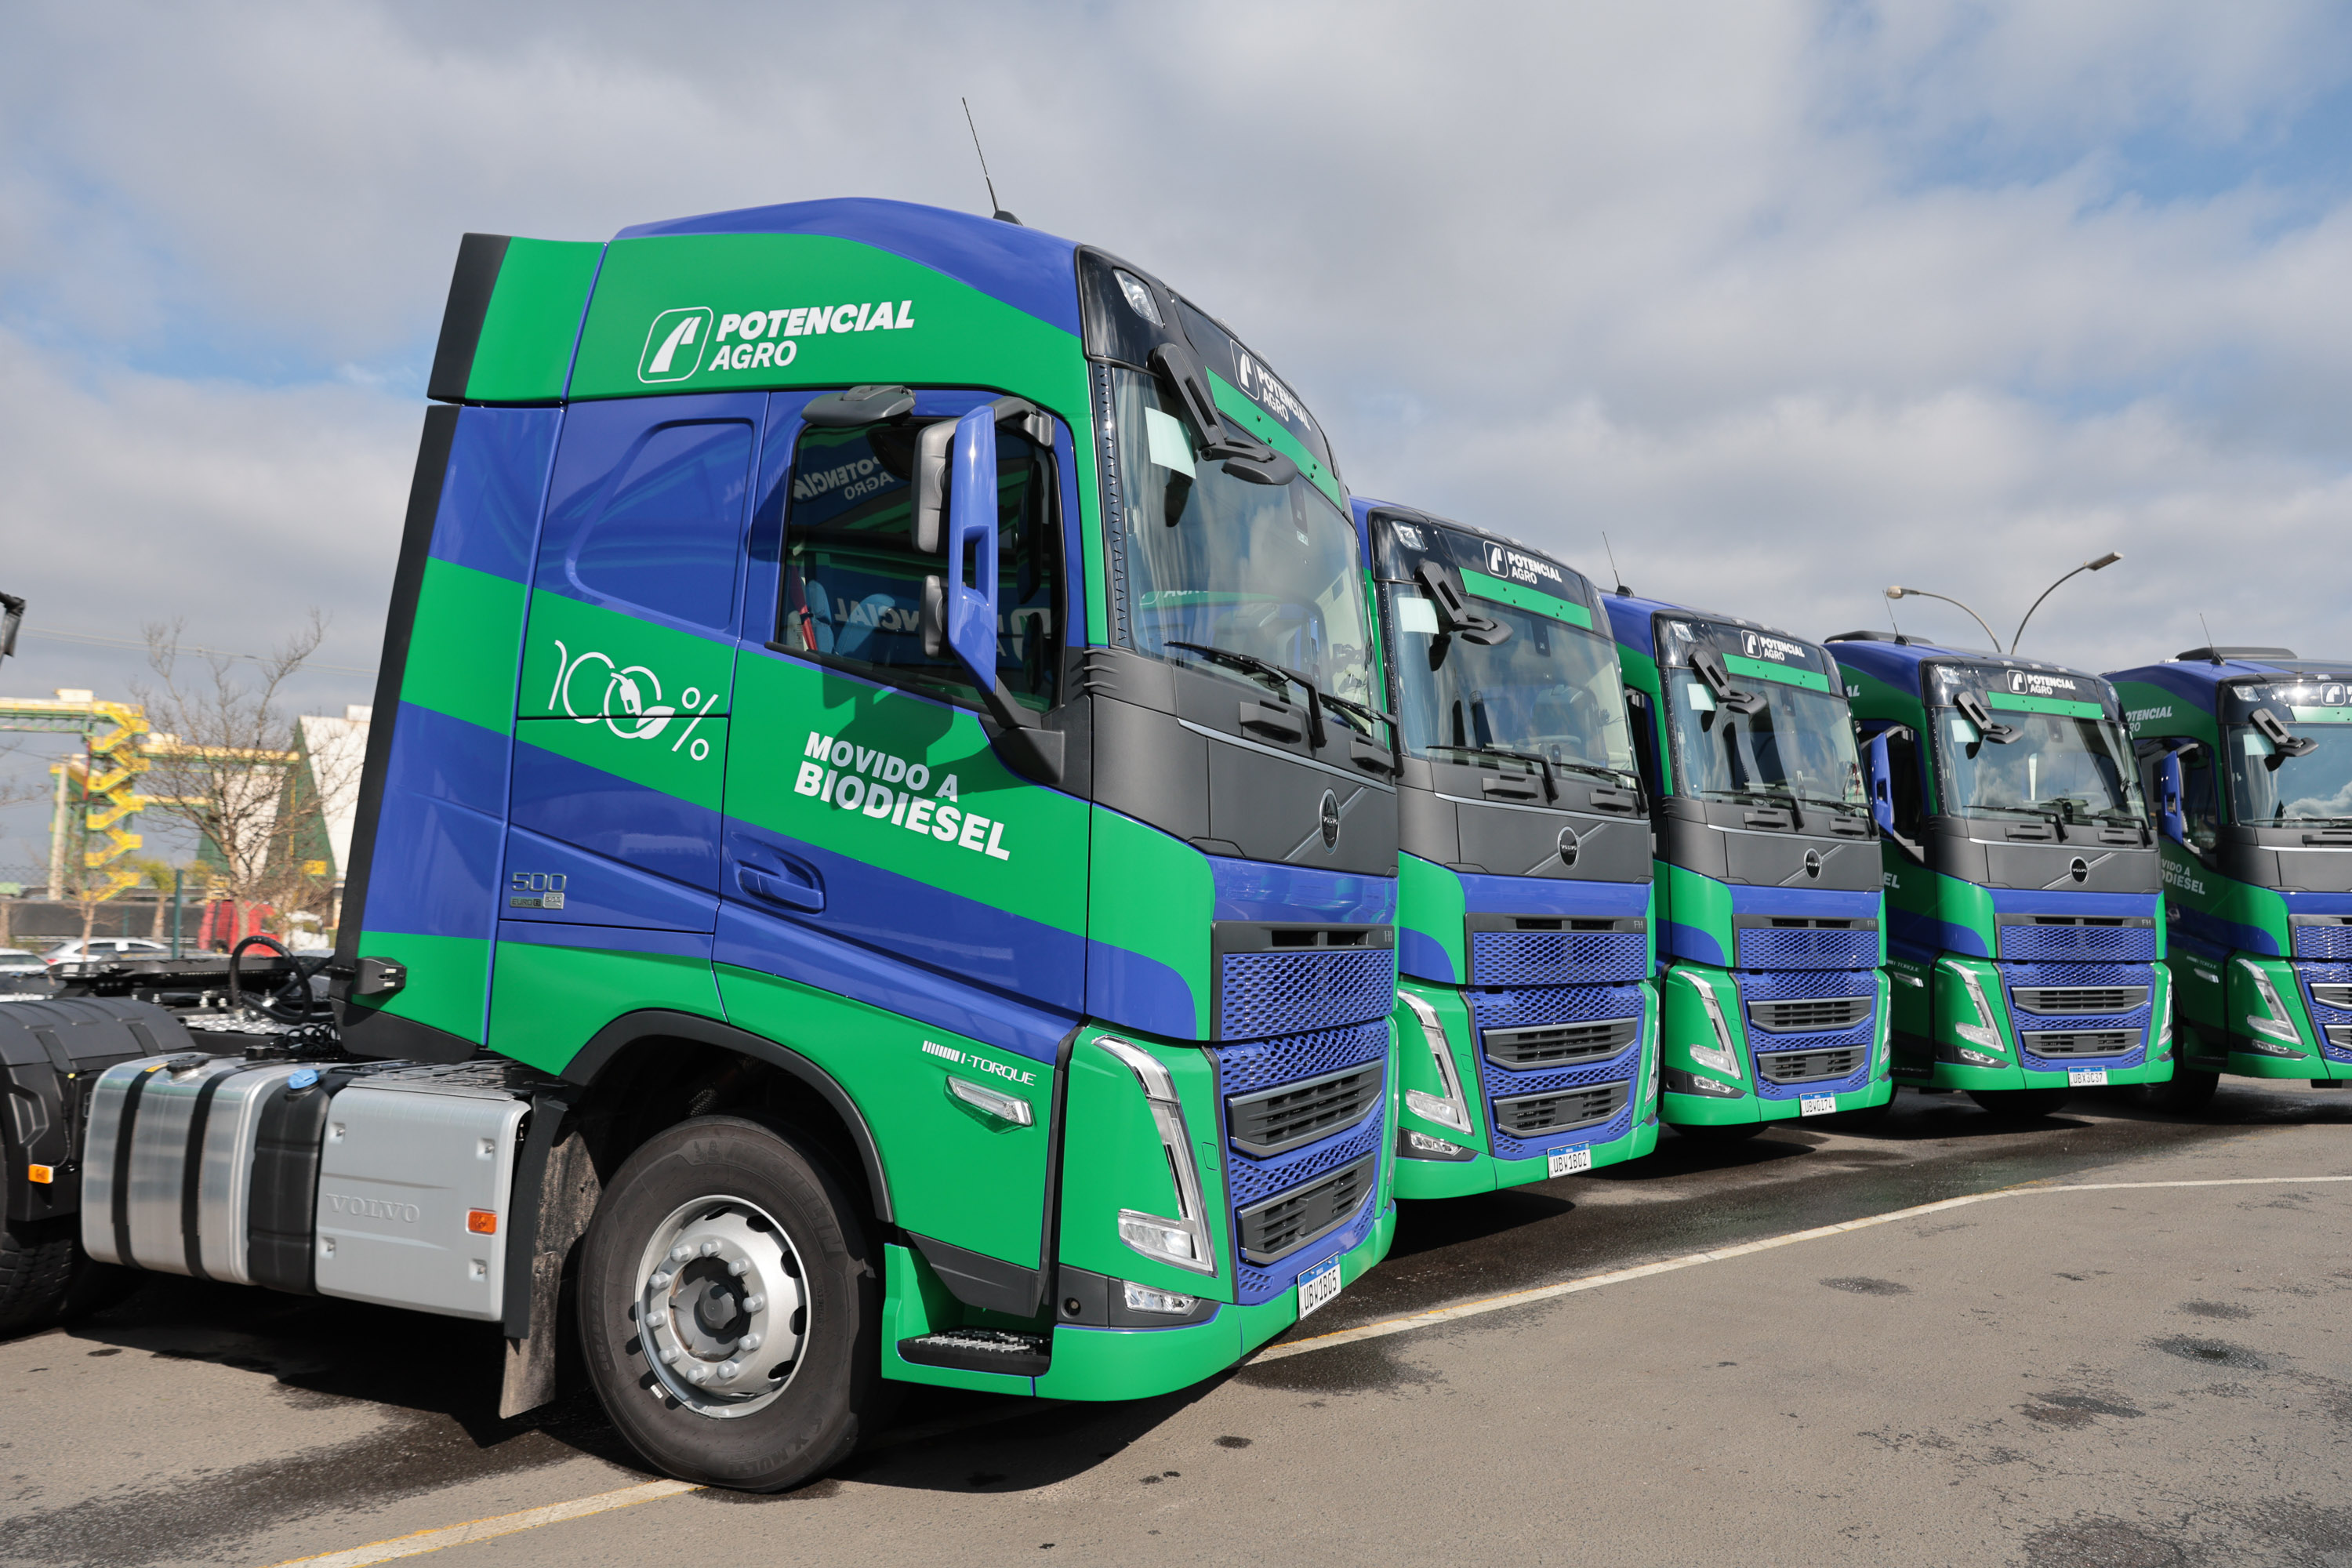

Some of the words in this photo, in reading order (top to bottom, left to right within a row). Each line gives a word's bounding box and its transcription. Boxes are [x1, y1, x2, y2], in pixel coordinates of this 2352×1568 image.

[715, 300, 915, 342] POTENCIAL
[708, 340, 797, 372] AGRO
[1256, 363, 1312, 431] POTENCIAL
[1262, 387, 1290, 423] AGRO
[1507, 550, 1563, 583] POTENCIAL
[1512, 566, 1537, 585] AGRO
[1760, 636, 1805, 658] POTENCIAL
[1764, 647, 1785, 662] AGRO
[2027, 676, 2076, 691] POTENCIAL
[2030, 684, 2053, 695] AGRO
[2125, 706, 2172, 721] OTENCIAL
[803, 731, 930, 792] MOVIDO
[935, 773, 958, 804] A
[793, 760, 1011, 862] BIODIESEL
[2161, 858, 2183, 873] VIDO
[2183, 866, 2190, 877] A
[511, 872, 567, 892] 500
[1634, 920, 1643, 929] FH
[960, 1052, 1037, 1087] I-TORQUE
[2073, 1073, 2103, 1083] UBX3C37
[1553, 1152, 1587, 1173] UBW1B02
[326, 1193, 420, 1223] VOLVO
[1304, 1269, 1337, 1311] UBW1B05
